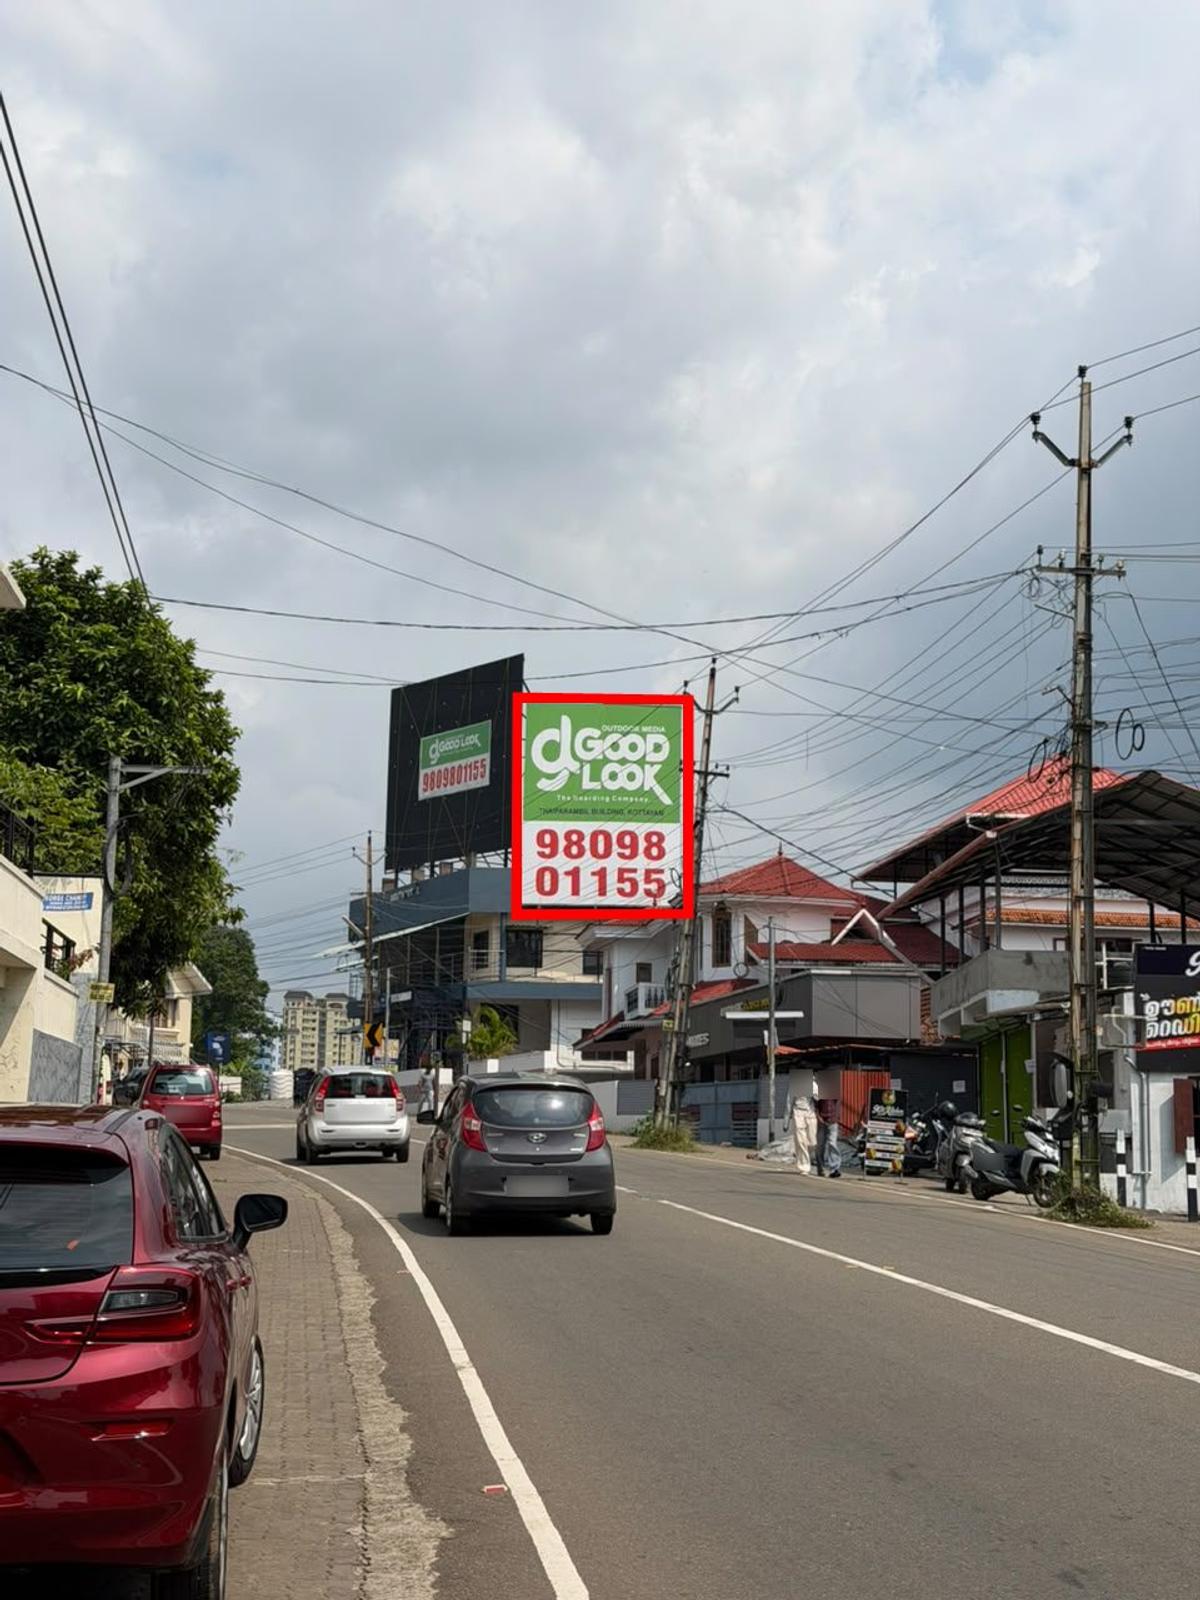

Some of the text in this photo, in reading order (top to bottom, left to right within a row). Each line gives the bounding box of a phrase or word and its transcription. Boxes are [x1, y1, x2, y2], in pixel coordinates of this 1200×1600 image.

[574, 727, 670, 762] GOOD
[422, 758, 487, 793] 9809801155
[582, 762, 673, 805] LOOK
[536, 829, 666, 861] 98098
[536, 866, 666, 899] 01155
